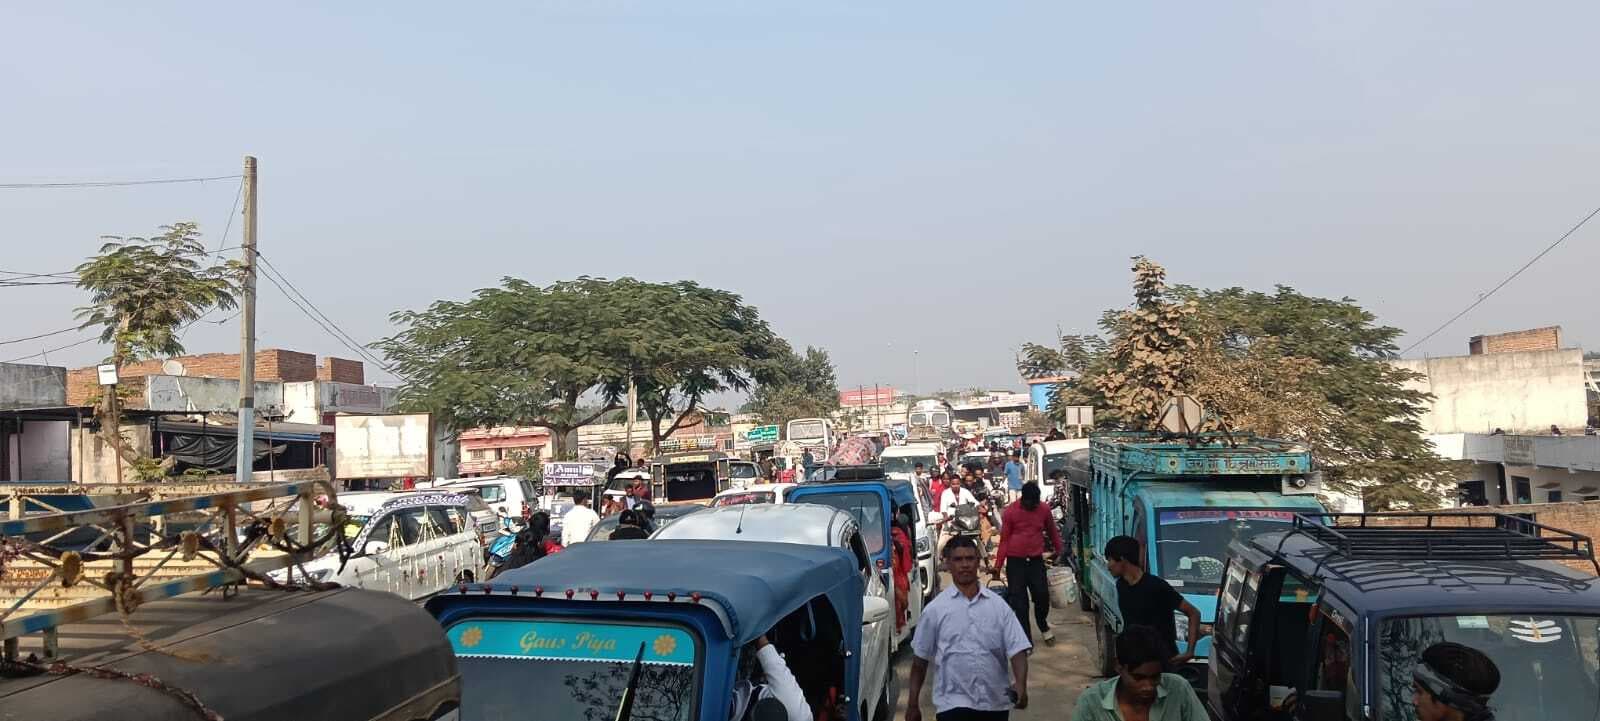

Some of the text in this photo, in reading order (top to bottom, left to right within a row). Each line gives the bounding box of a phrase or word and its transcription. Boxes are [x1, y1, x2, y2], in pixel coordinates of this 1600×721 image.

[554, 464, 582, 474] Amul
[519, 630, 617, 656] Gaus Piya
